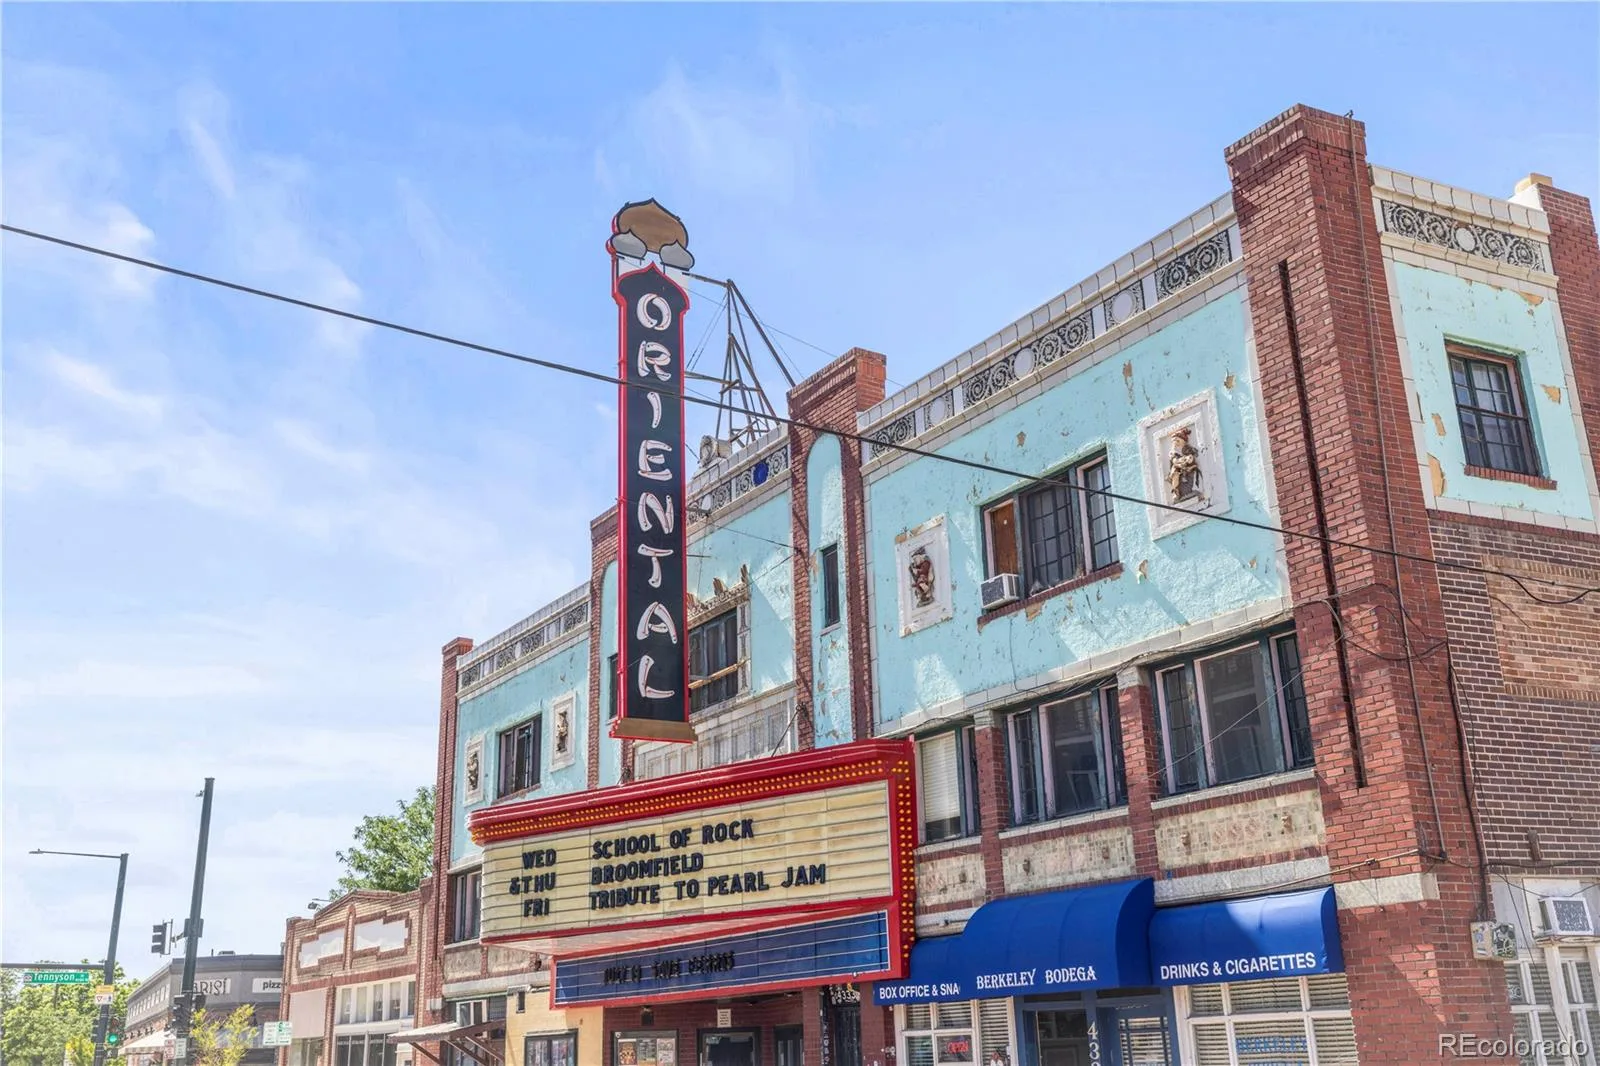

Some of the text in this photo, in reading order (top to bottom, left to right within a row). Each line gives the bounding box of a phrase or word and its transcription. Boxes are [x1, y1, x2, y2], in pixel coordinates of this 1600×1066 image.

[635, 292, 677, 700] ORIENTAL
[592, 818, 755, 860] SCHOOL OF ROCK
[522, 848, 557, 870] WED
[591, 852, 704, 886] BROOMFIELD
[589, 863, 827, 911] TRIBUTE TO PEARL JAM
[523, 898, 550, 918] FRI
[34, 973, 75, 982] Tennyson
[976, 965, 1098, 990] BERKELEY BODEGA
[1160, 951, 1317, 981] DRINKS & CIGARETTES
[262, 980, 282, 990] pizz
[879, 982, 961, 1000] BOX OFFICE & SNA
